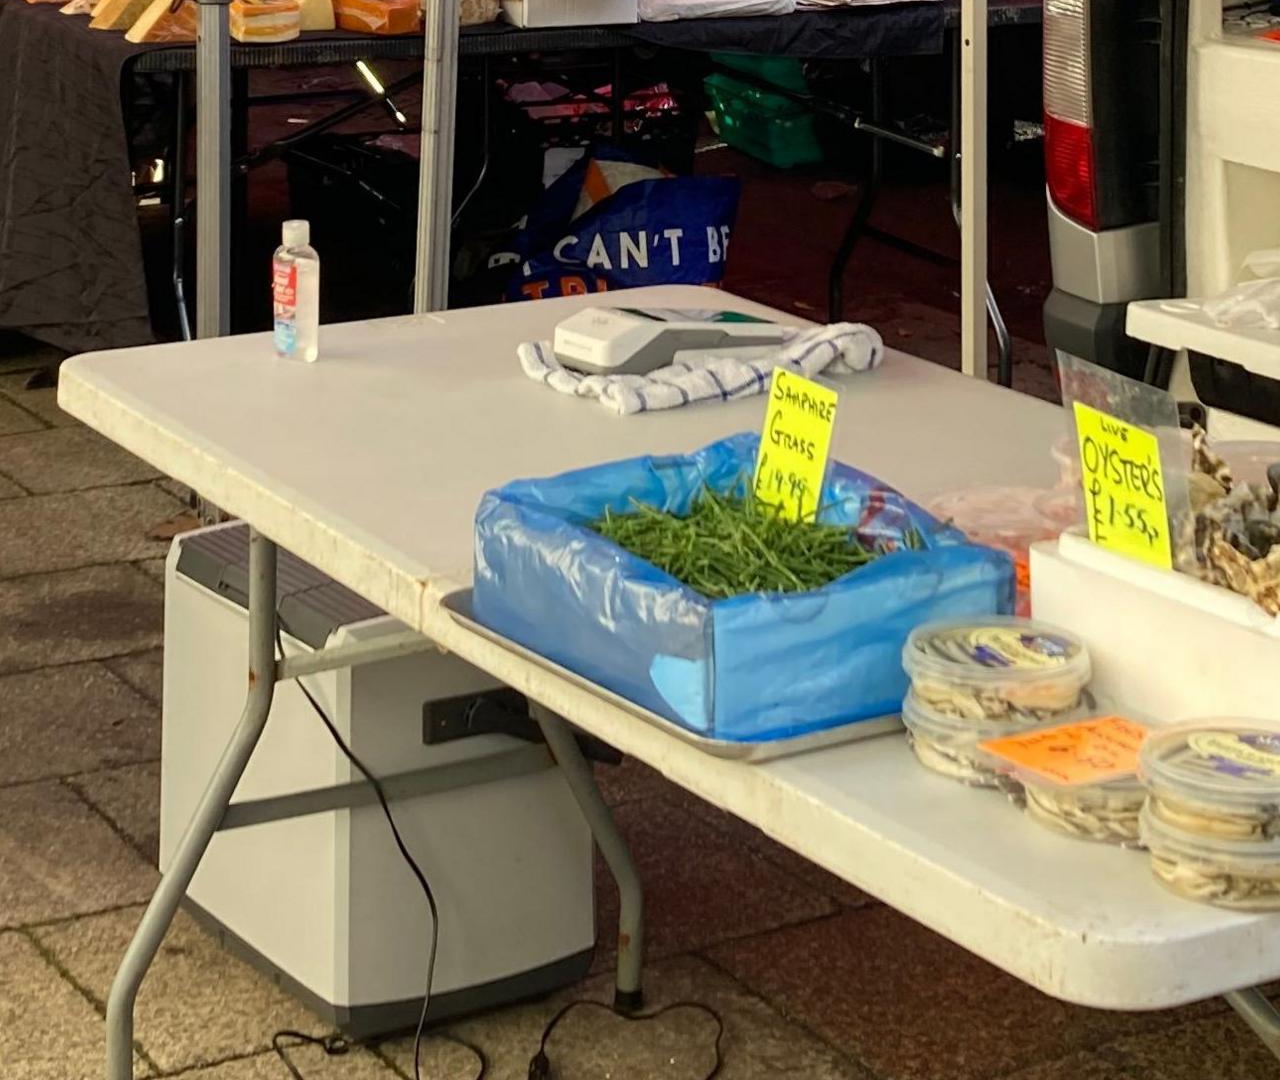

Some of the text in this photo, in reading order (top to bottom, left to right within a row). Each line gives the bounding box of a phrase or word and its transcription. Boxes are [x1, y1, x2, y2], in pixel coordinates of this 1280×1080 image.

[552, 227, 685, 271] CAN'T
[773, 371, 837, 423] SAMPHIRE
[769, 409, 816, 461] GRASS
[1099, 416, 1129, 443] LIVE
